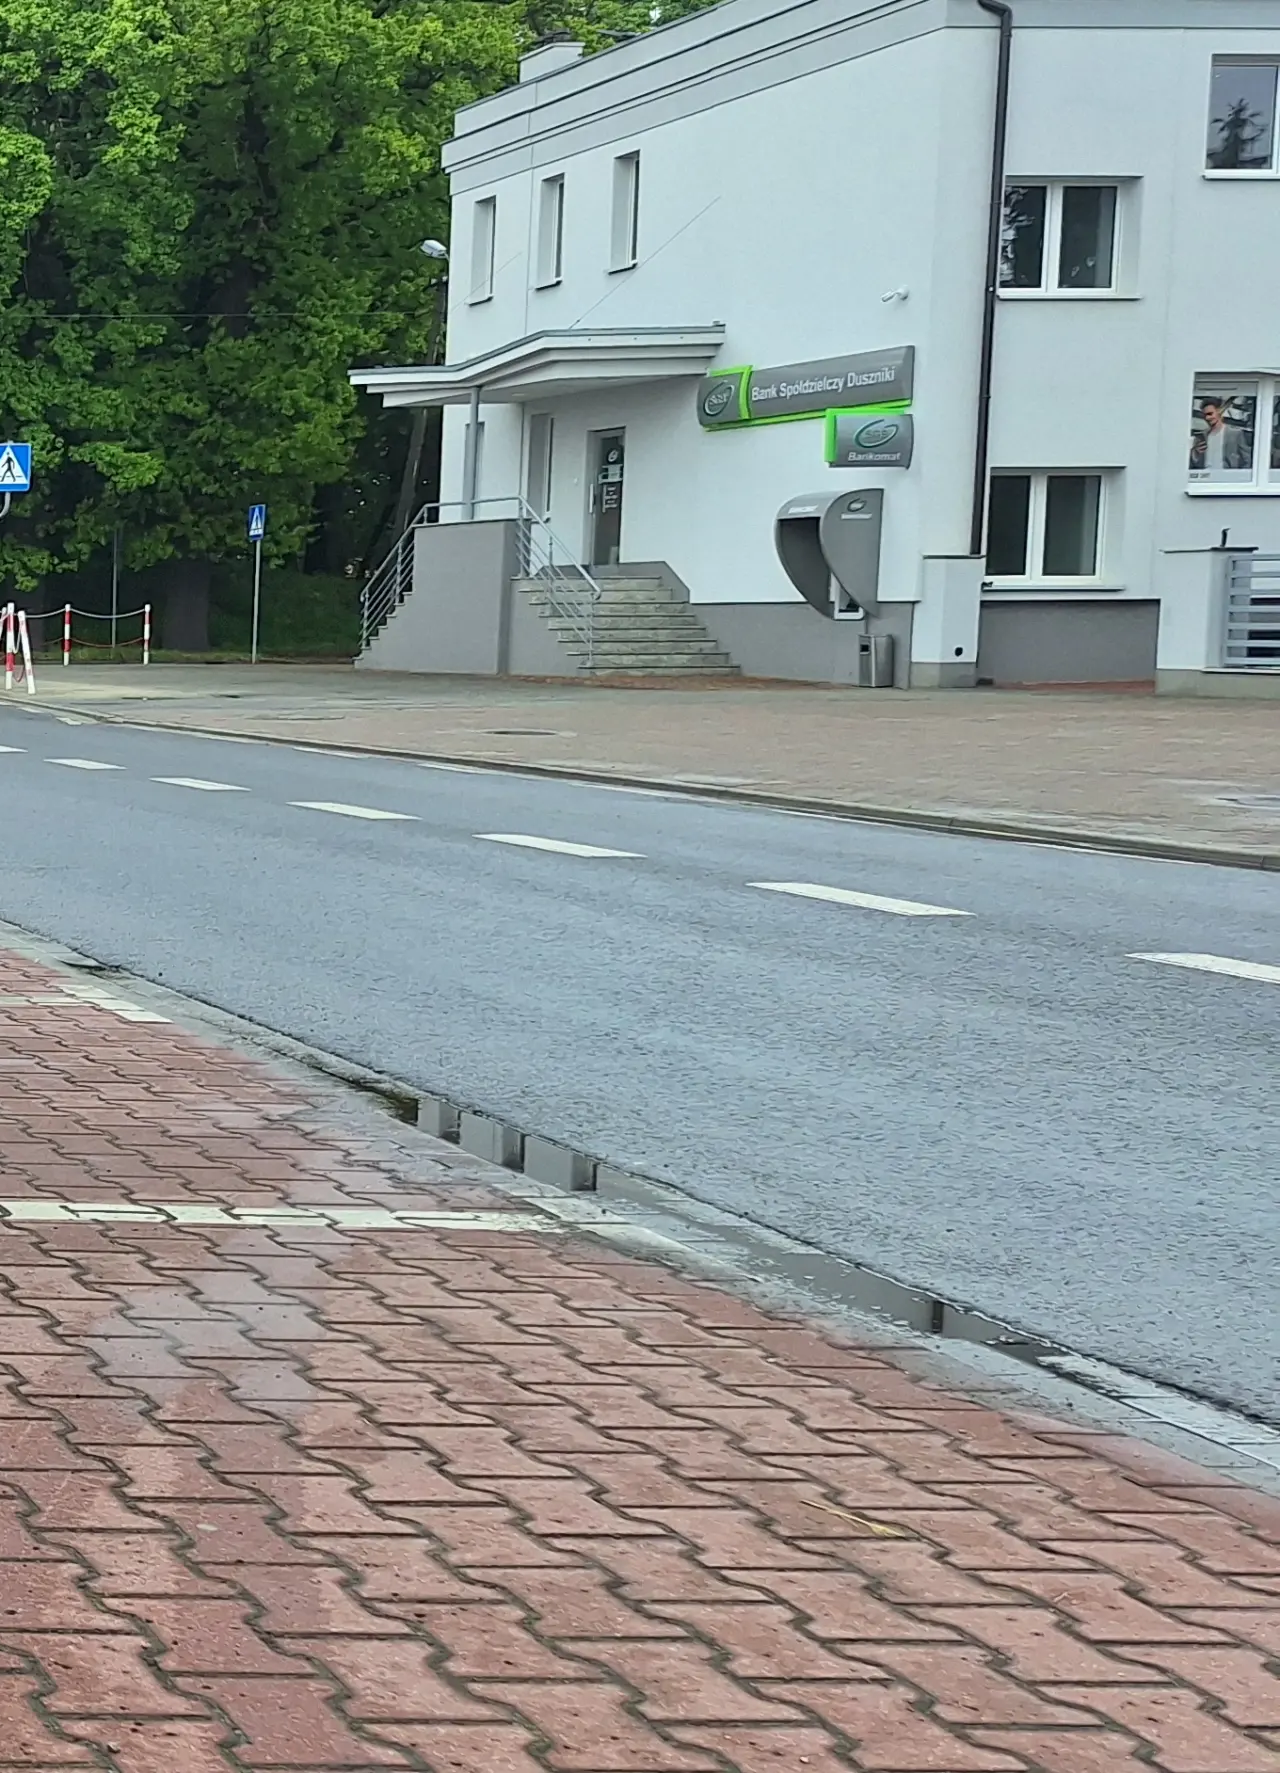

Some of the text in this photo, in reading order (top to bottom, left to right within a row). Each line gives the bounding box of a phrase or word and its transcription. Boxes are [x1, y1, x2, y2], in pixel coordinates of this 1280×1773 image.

[751, 366, 896, 401] Bank Spółdzielczy Duszniki
[847, 451, 902, 461] Bankomat
